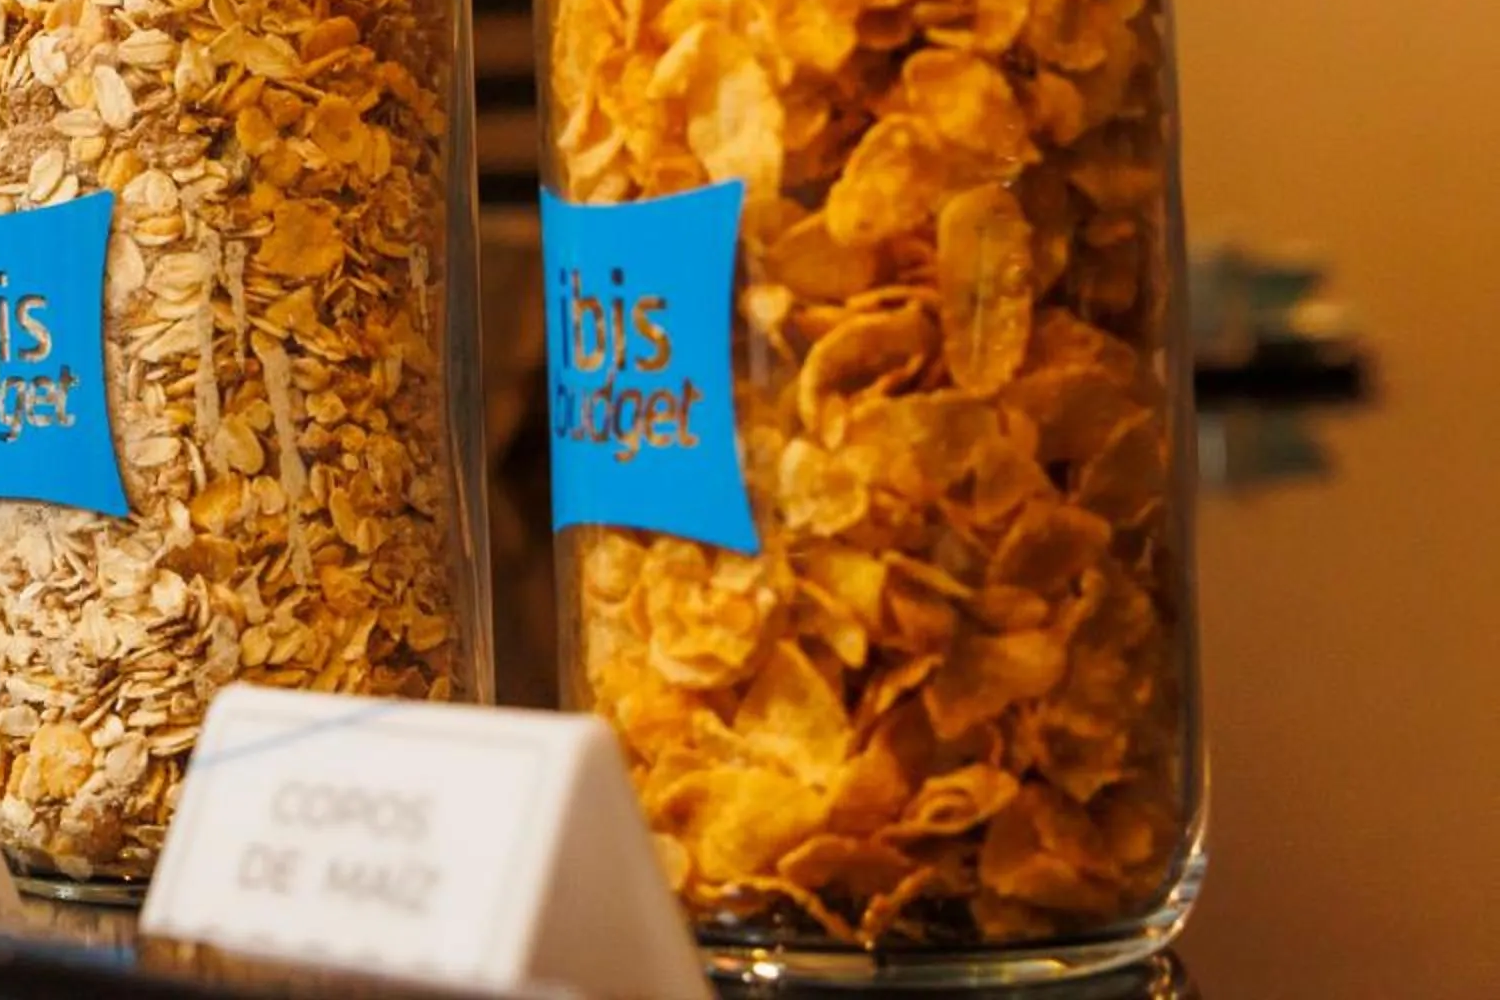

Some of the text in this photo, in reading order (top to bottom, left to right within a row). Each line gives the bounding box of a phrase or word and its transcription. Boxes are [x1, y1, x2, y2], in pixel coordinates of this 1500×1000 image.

[560, 267, 672, 371] ibis
[553, 365, 702, 462] budget
[270, 779, 436, 843] COPOS
[236, 841, 303, 894] DE
